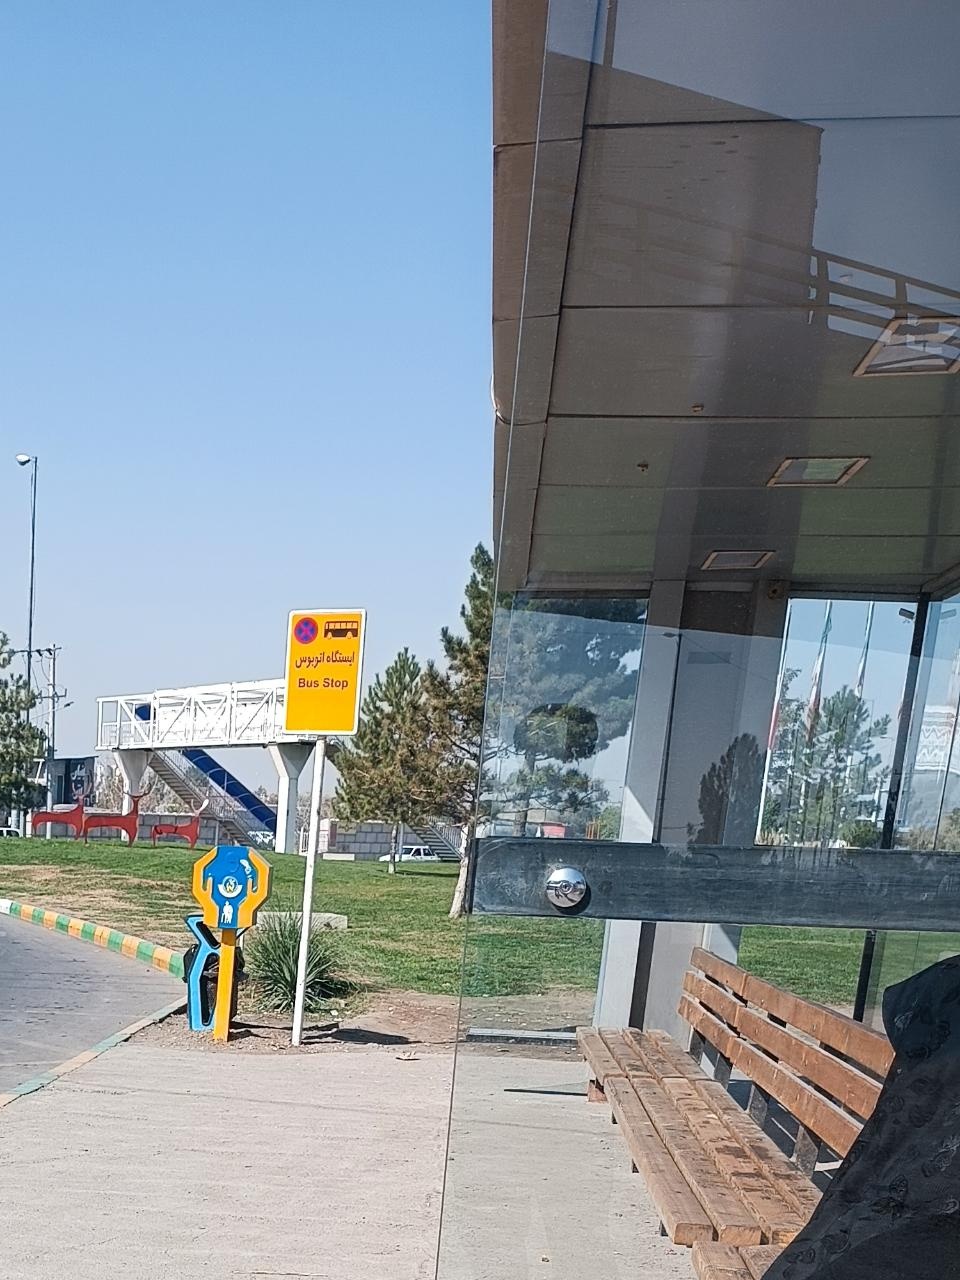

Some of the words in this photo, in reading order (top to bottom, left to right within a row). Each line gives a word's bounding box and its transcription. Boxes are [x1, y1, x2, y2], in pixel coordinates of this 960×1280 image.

[295, 651, 324, 668] اتوبوس
[326, 650, 354, 666] ایستگاه
[298, 677, 319, 688] Bus
[322, 677, 348, 690] Stop
